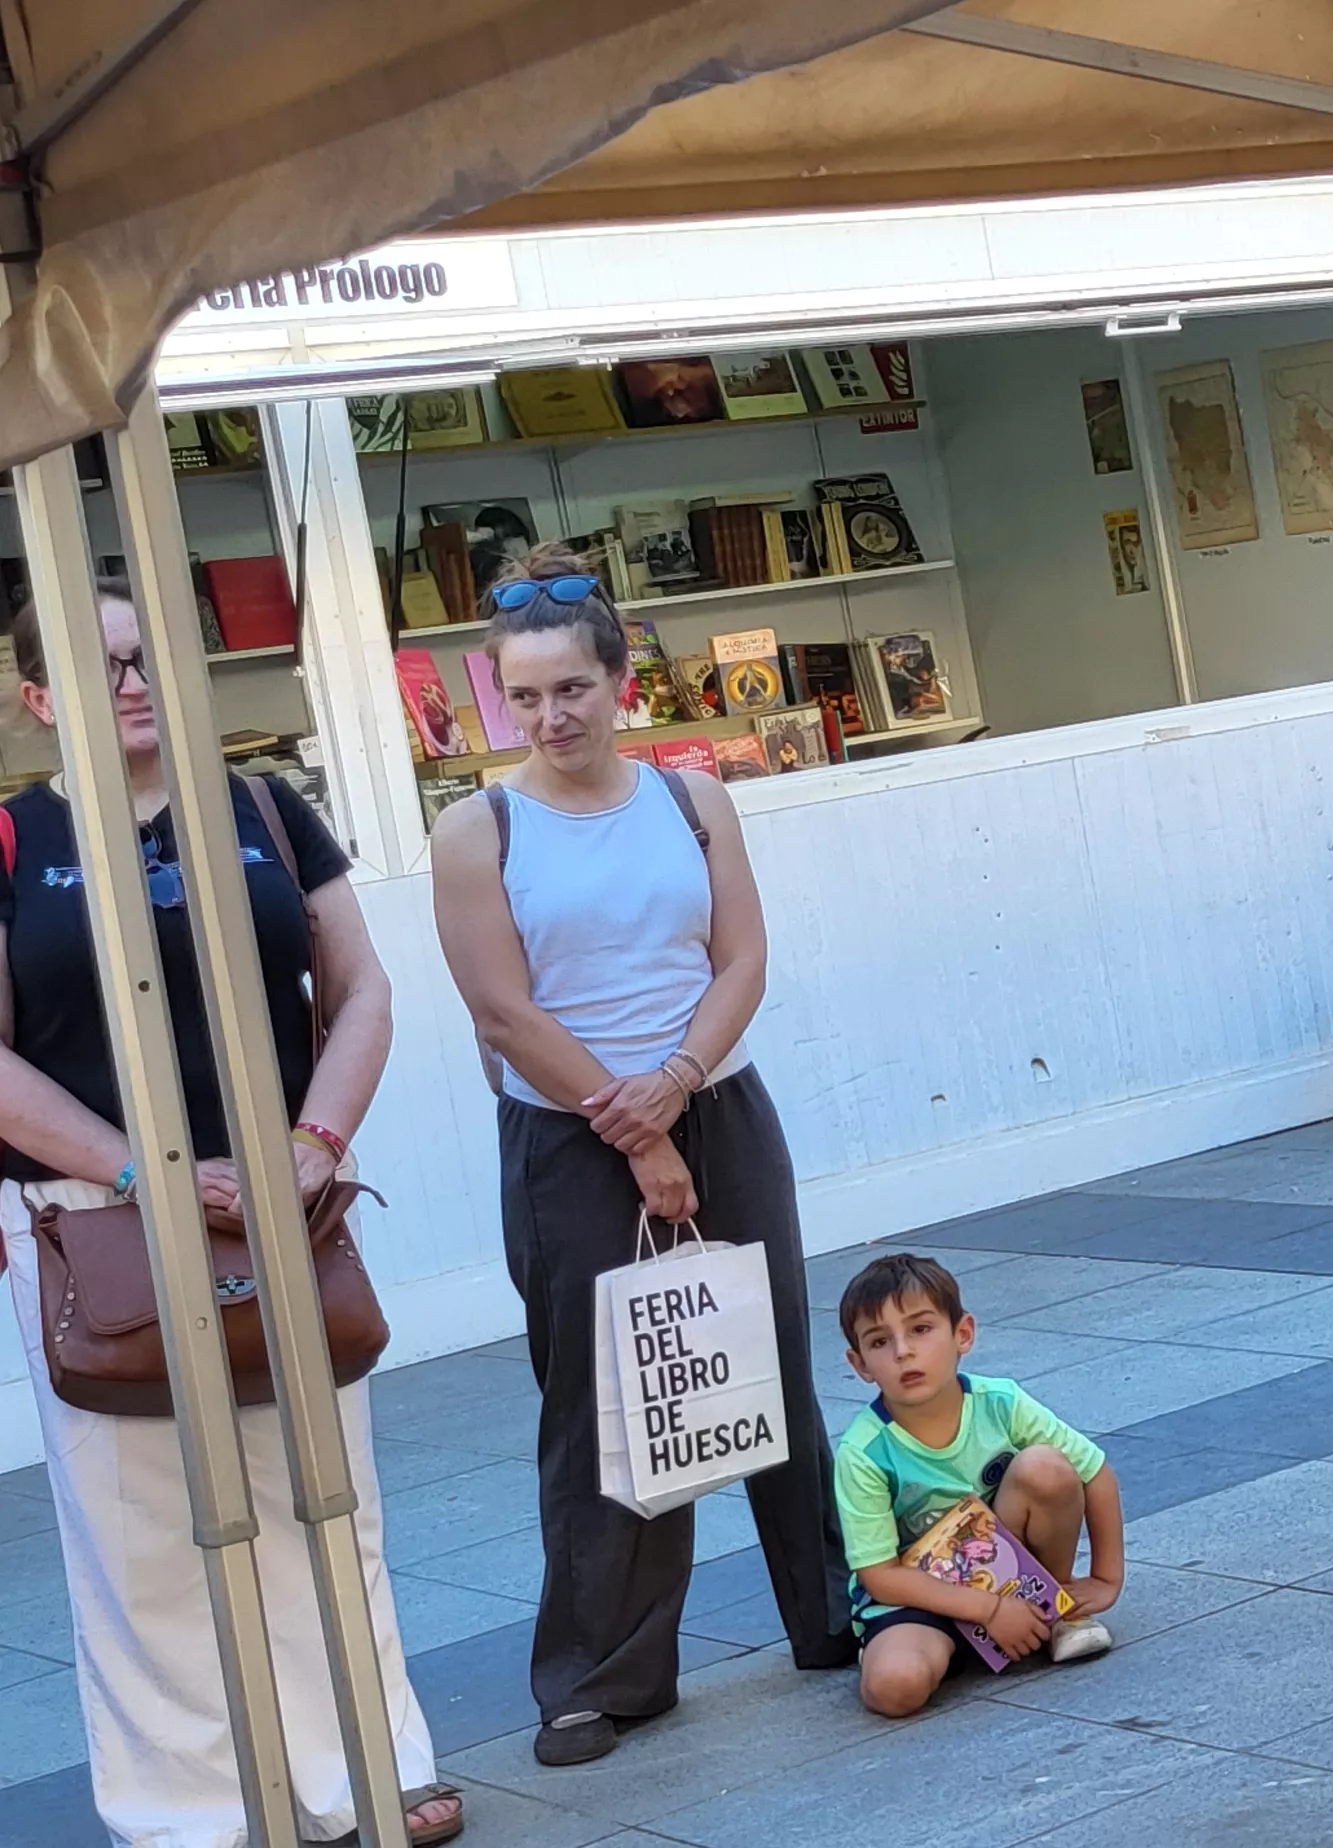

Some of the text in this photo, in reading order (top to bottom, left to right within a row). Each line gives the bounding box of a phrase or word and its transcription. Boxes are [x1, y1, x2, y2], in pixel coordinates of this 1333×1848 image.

[293, 258, 449, 305] Prólogo
[629, 1281, 720, 1333] FERIA
[634, 1324, 694, 1368] DEL
[640, 1351, 730, 1404] LIBRO
[645, 1399, 685, 1440] DE
[649, 1412, 774, 1476] HUESCA
